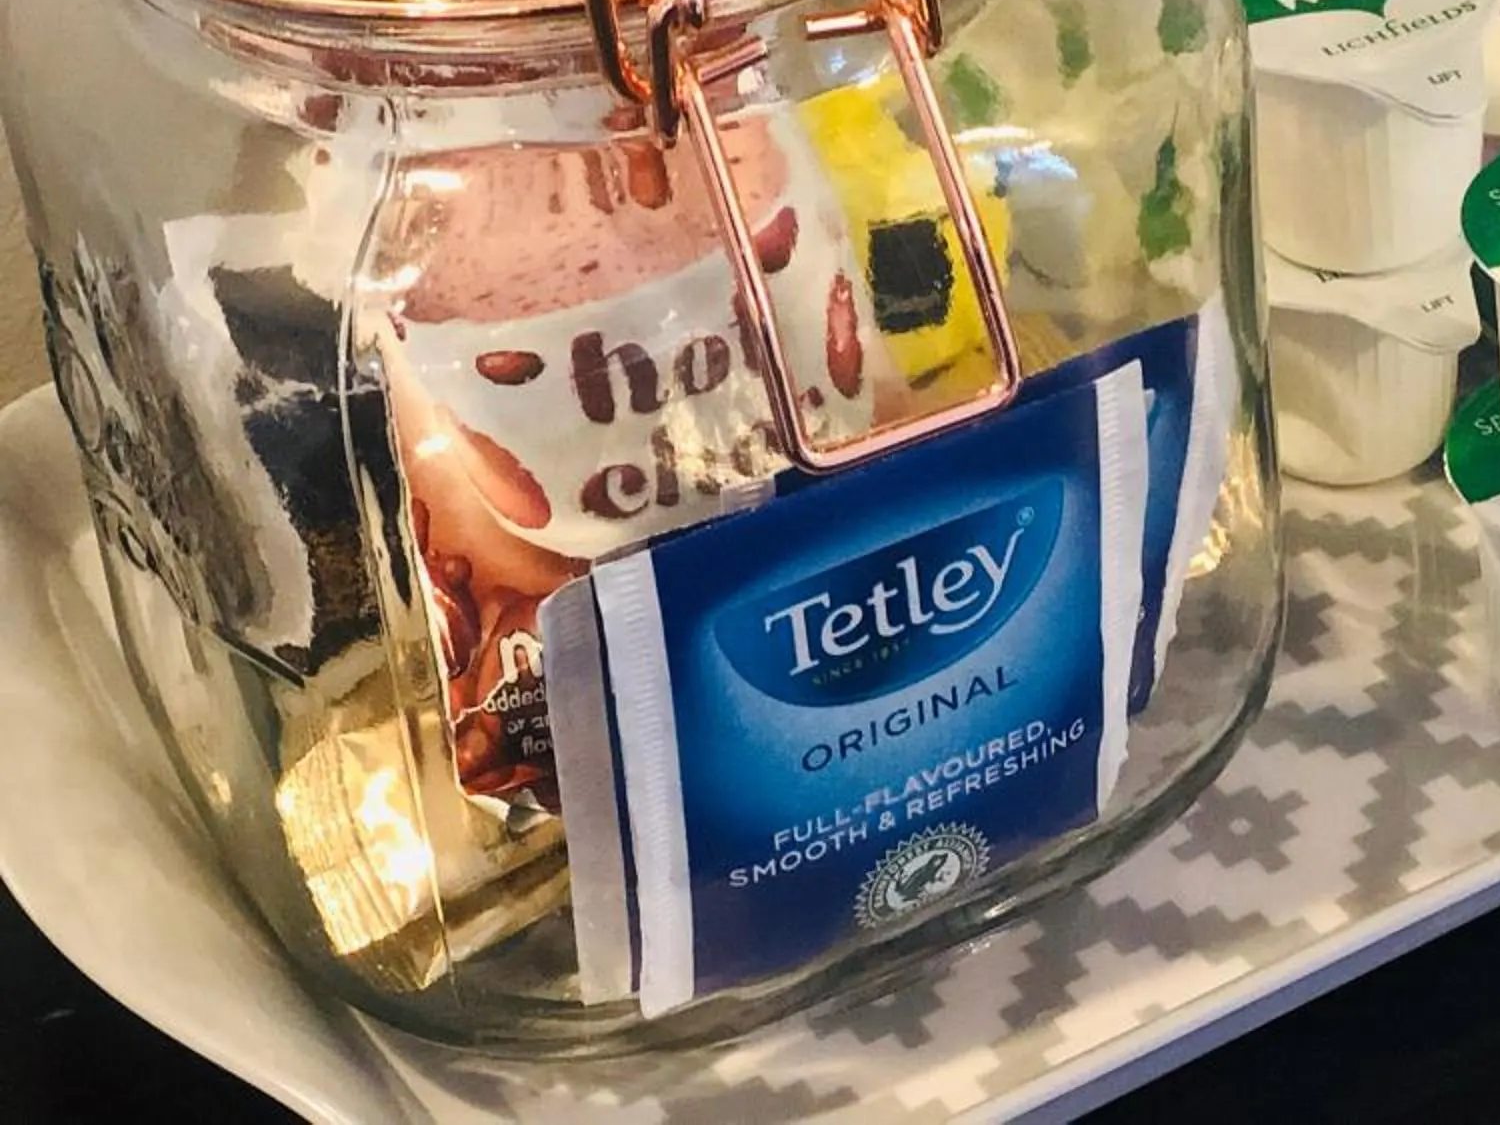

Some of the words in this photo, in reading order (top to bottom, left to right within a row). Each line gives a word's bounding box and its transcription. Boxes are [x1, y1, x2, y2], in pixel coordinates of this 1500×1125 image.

[1421, 294, 1454, 313] LIFT
[764, 527, 1025, 677] Tetley
[773, 719, 1052, 851] FULL-FLAVOURED,
[801, 665, 1019, 773] ORIGINAL
[728, 824, 868, 888] SMOOTH
[878, 811, 897, 831] &
[907, 717, 1086, 820] REFRESHING
